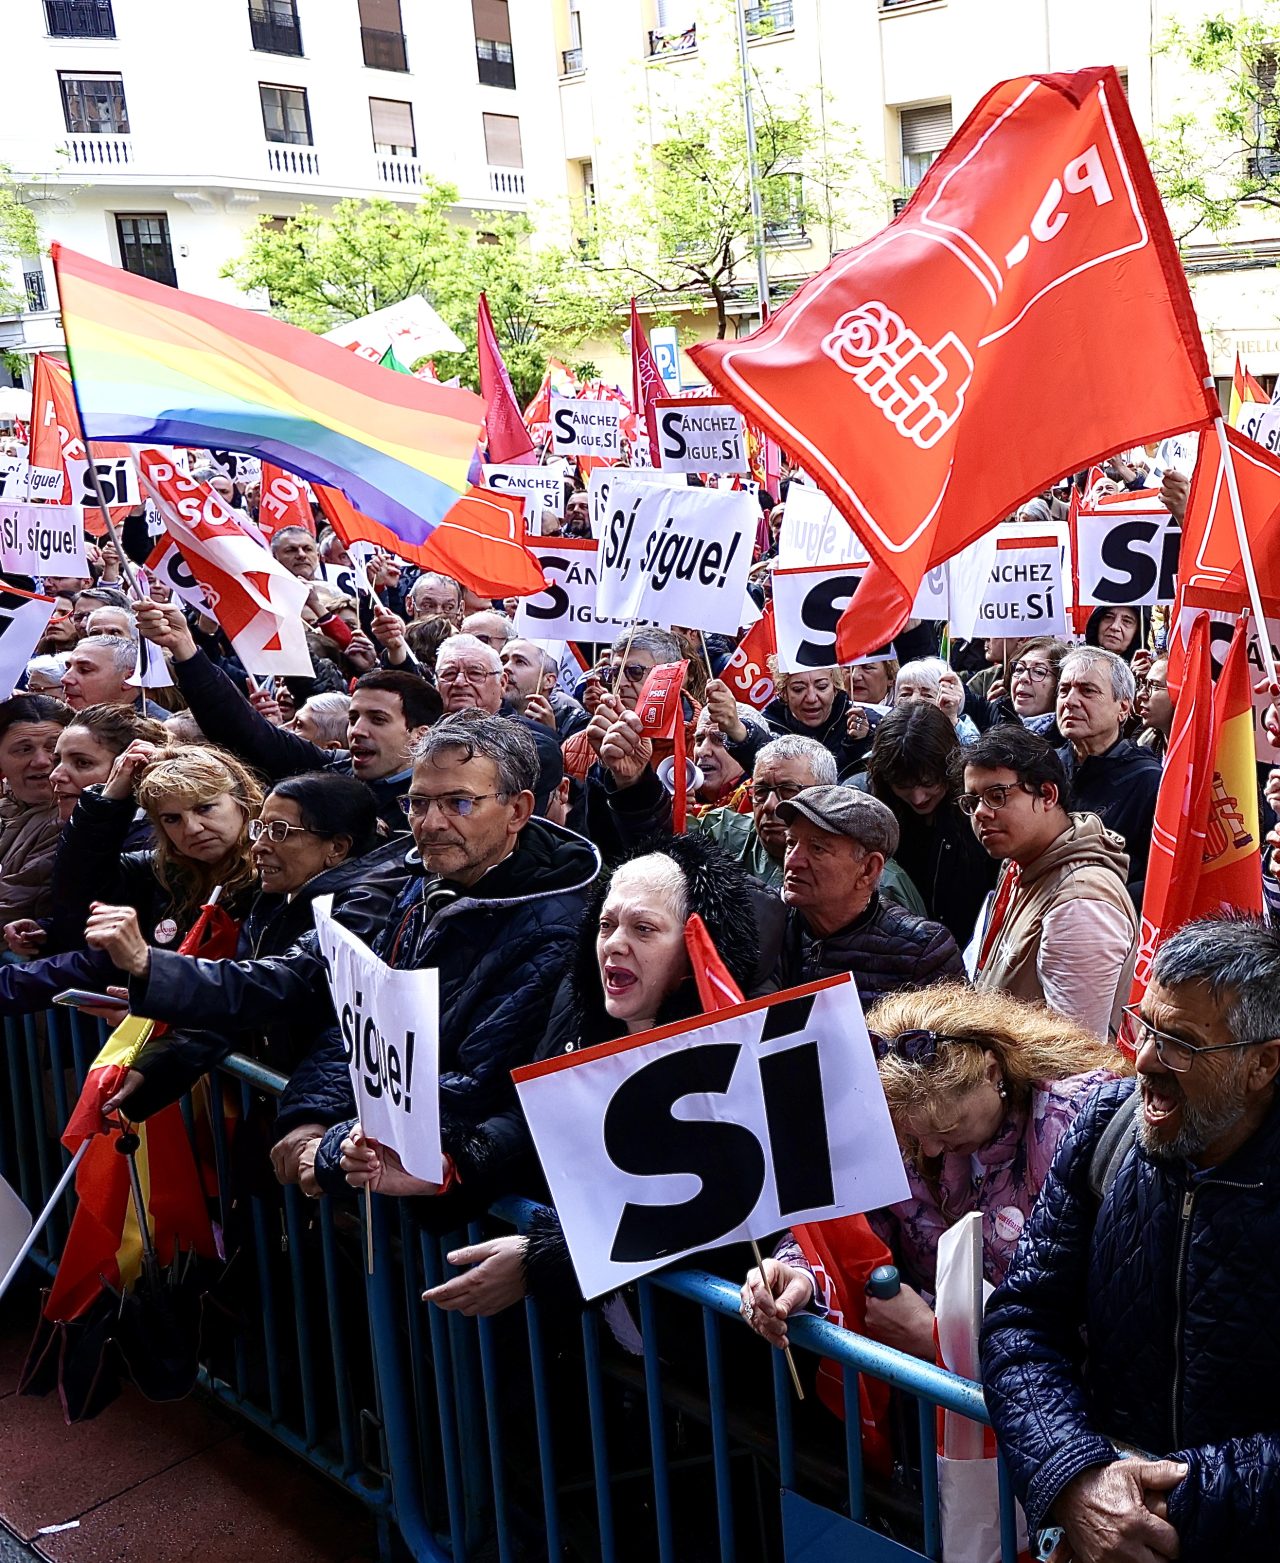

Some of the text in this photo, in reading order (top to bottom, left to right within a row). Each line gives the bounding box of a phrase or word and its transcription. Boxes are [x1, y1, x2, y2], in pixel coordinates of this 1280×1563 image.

[81, 460, 128, 506] SÍ
[27, 521, 78, 561] sigue!
[640, 517, 742, 592] sigue!
[340, 990, 416, 1115] sigue!
[603, 993, 836, 1264] SÍ
